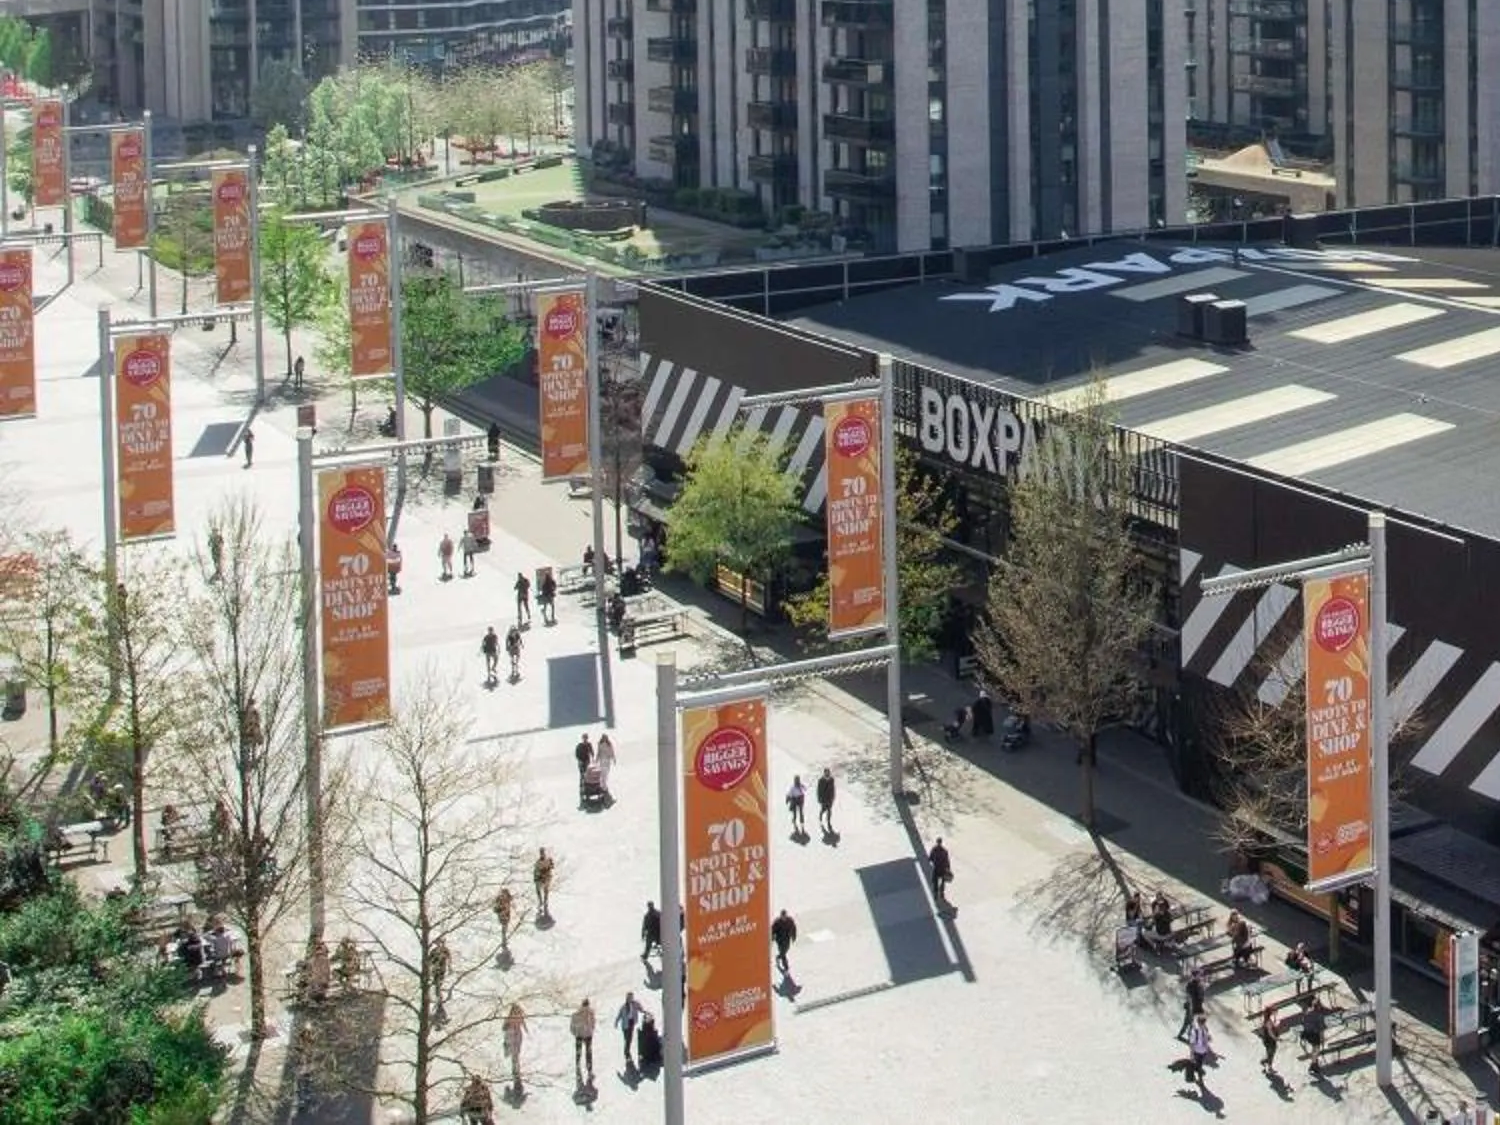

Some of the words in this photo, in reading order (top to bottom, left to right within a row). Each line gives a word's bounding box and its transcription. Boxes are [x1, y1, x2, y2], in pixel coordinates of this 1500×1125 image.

[360, 273, 378, 286] 70
[552, 355, 573, 371] 70
[131, 403, 157, 421] 70
[840, 476, 867, 497] 70
[835, 518, 874, 537] SHOP
[338, 554, 369, 577] 70
[325, 586, 366, 608] DINE
[331, 601, 377, 621] SHOP
[1325, 677, 1353, 705] 70
[1312, 704, 1349, 724] SPOTS
[1351, 698, 1367, 713] TO
[1313, 718, 1350, 741] DINE
[1355, 713, 1367, 731] &
[703, 745, 747, 765] BIGGER
[1319, 732, 1361, 757] SHOP
[708, 818, 745, 851] 70
[690, 852, 739, 876] SPOTS
[743, 844, 765, 862] TO
[691, 864, 741, 896] DINE
[748, 859, 765, 881] &
[699, 882, 755, 914] SHOP
